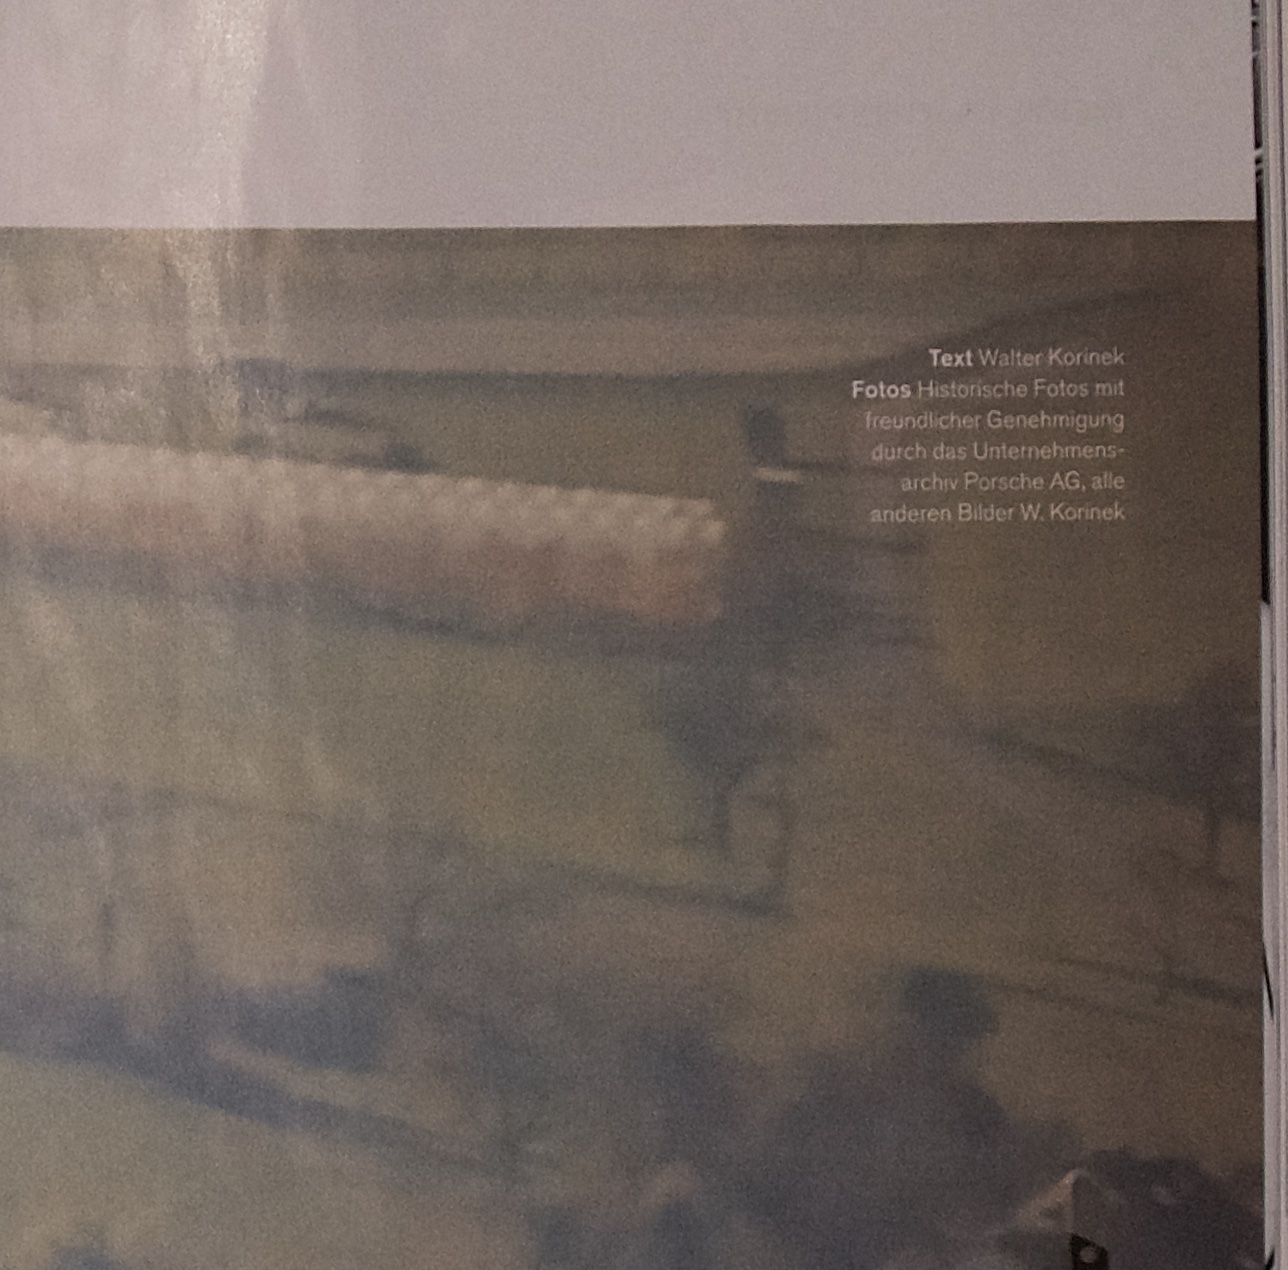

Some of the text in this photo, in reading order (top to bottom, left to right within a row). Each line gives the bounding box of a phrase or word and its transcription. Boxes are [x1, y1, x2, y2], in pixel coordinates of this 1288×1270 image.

[929, 347, 1124, 367] Text Walter Korinek
[852, 378, 1124, 399] Fotos Historische Fotos mit
[866, 410, 1124, 433] freundlicher Genehmigung
[872, 441, 1125, 461] durch das Unternehmens-
[901, 471, 1124, 492] archiv Porsche AG, alle
[872, 502, 1124, 523] anderen Bilder W. Korinek
